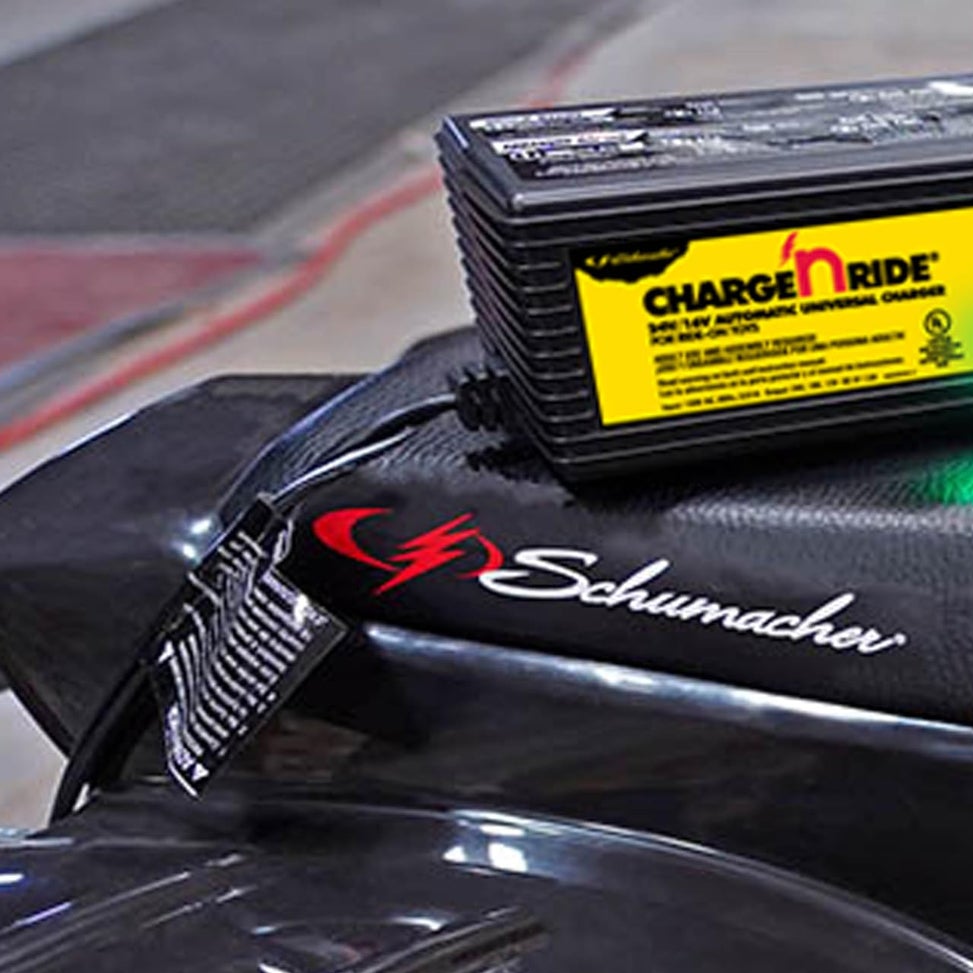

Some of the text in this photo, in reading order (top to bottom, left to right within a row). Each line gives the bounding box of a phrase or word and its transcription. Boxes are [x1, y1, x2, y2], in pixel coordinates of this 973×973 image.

[643, 271, 797, 316] CHARGE
[847, 253, 931, 290] RIDE
[714, 304, 798, 325] AUTOMATIC
[800, 294, 878, 315] UNIVERSAL
[881, 285, 946, 303] CHARGER
[478, 547, 901, 655] Schumacher
